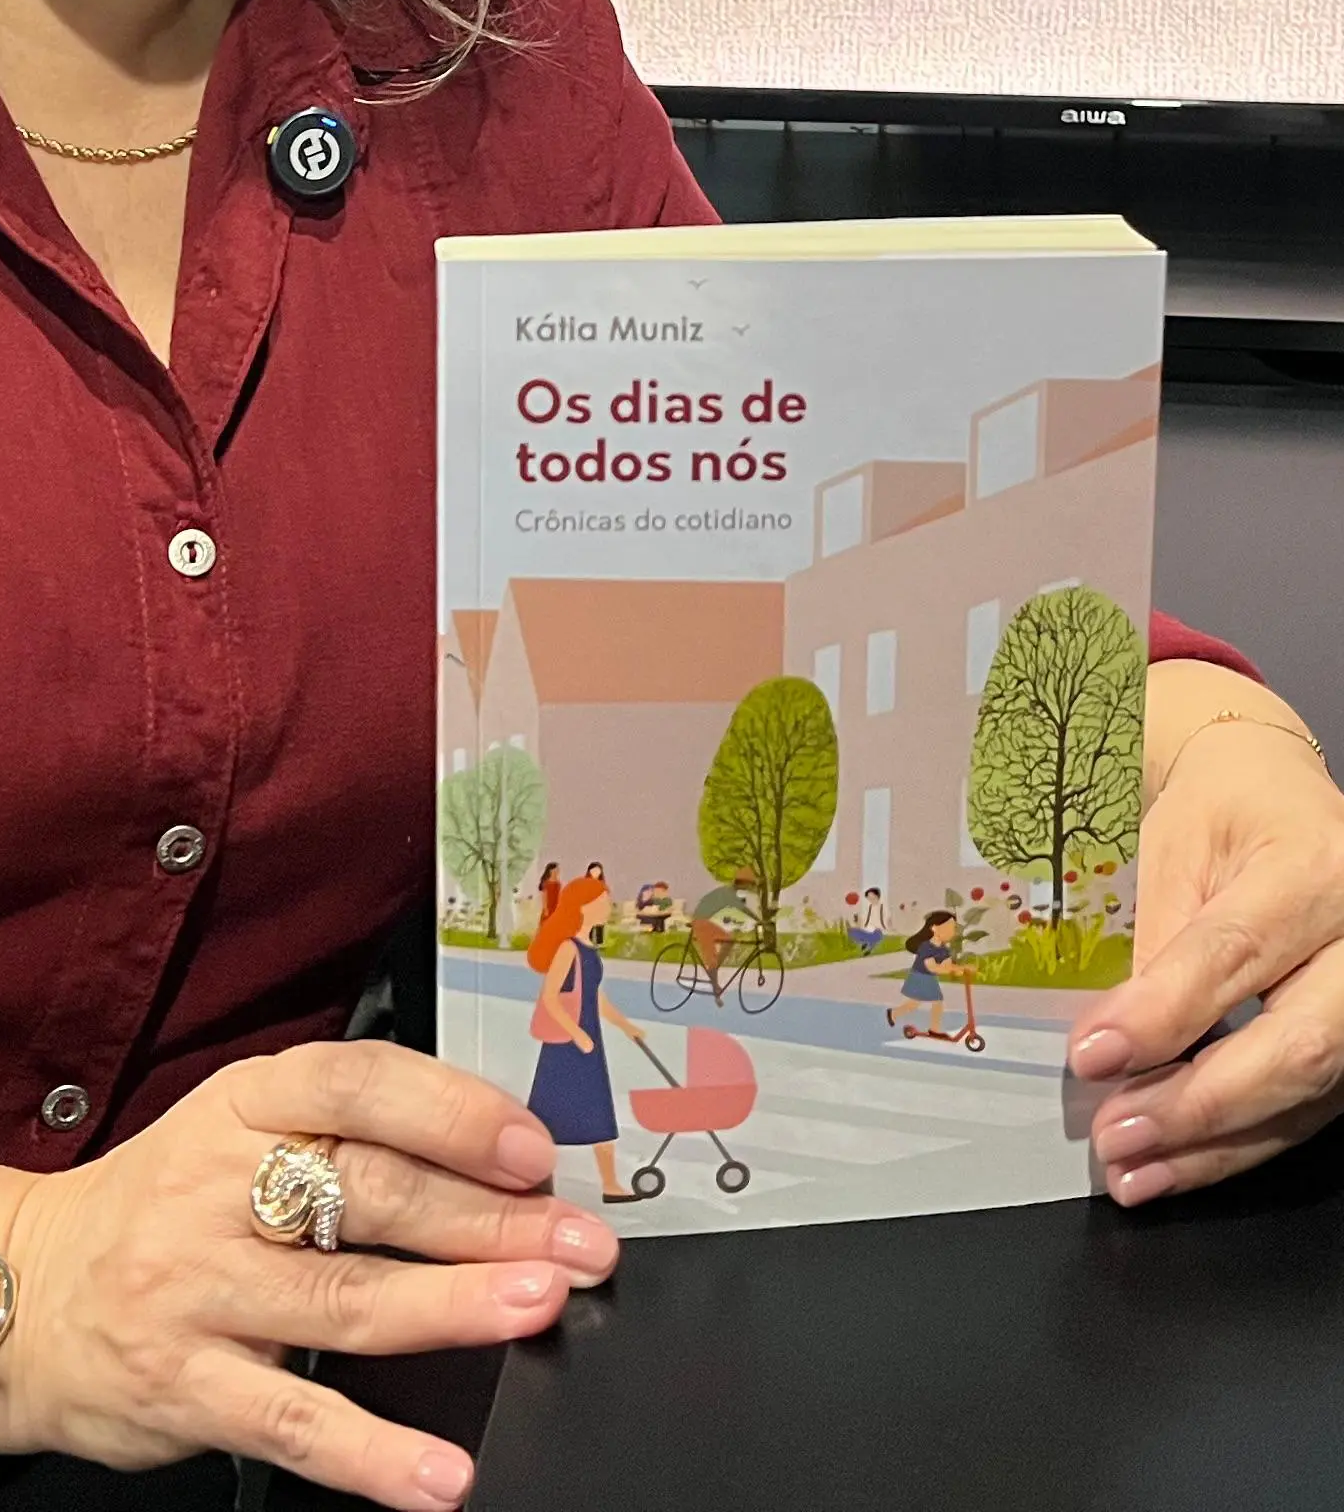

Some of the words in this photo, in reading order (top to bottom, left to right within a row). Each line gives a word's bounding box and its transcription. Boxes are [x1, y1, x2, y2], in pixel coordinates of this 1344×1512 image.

[1060, 109, 1126, 125] aiwa
[516, 313, 598, 341] Kátia
[609, 316, 704, 342] Muniz
[517, 379, 592, 424] Os
[610, 379, 724, 424] dias
[741, 379, 807, 424] de
[516, 438, 672, 483] todos
[691, 437, 787, 482] nós
[515, 509, 626, 532] Crônicas
[634, 508, 666, 531] do
[674, 508, 793, 531] cotidiano
